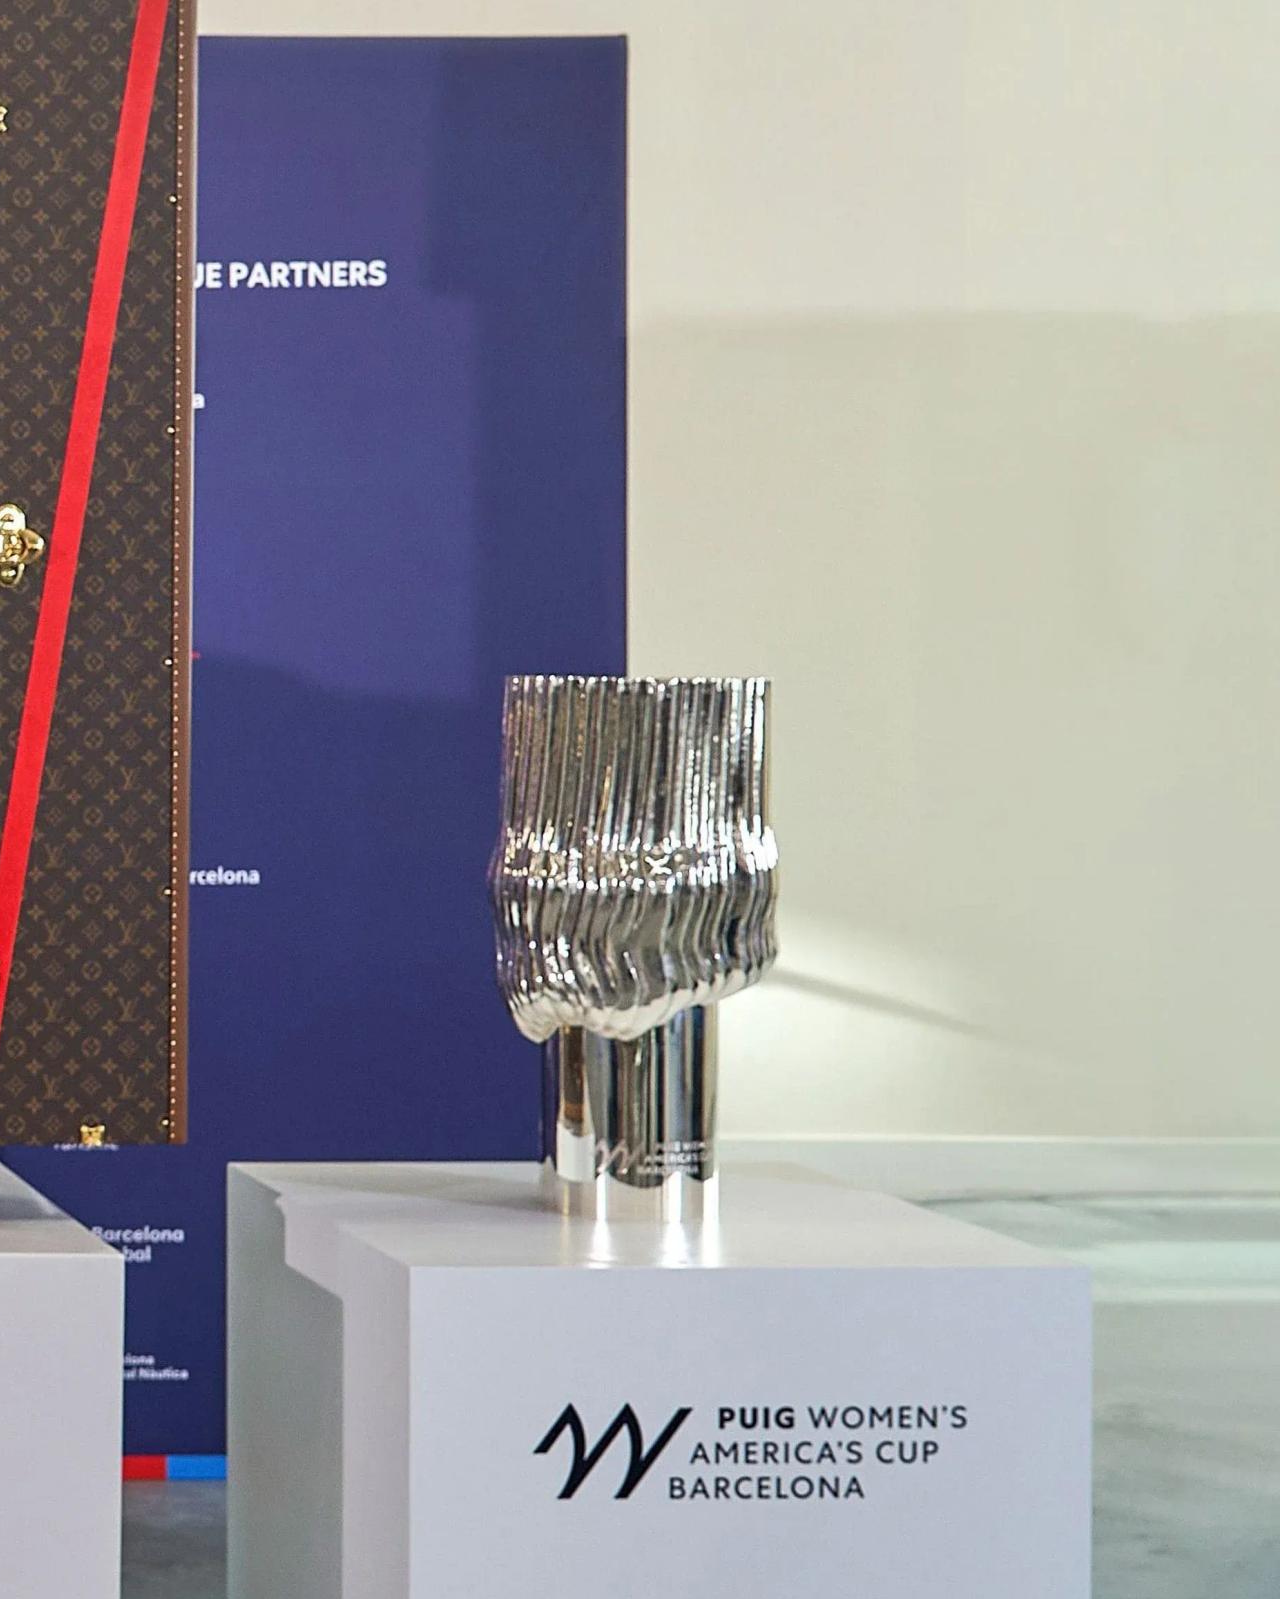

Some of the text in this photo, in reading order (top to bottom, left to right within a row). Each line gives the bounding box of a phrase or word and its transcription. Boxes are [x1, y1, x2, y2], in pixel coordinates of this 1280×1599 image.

[229, 260, 388, 288] PARTNERS
[718, 1405, 968, 1430] PUIG WOMEN'S
[689, 1440, 939, 1465] AMERICA'S CUP
[669, 1475, 865, 1500] BARCELONA
